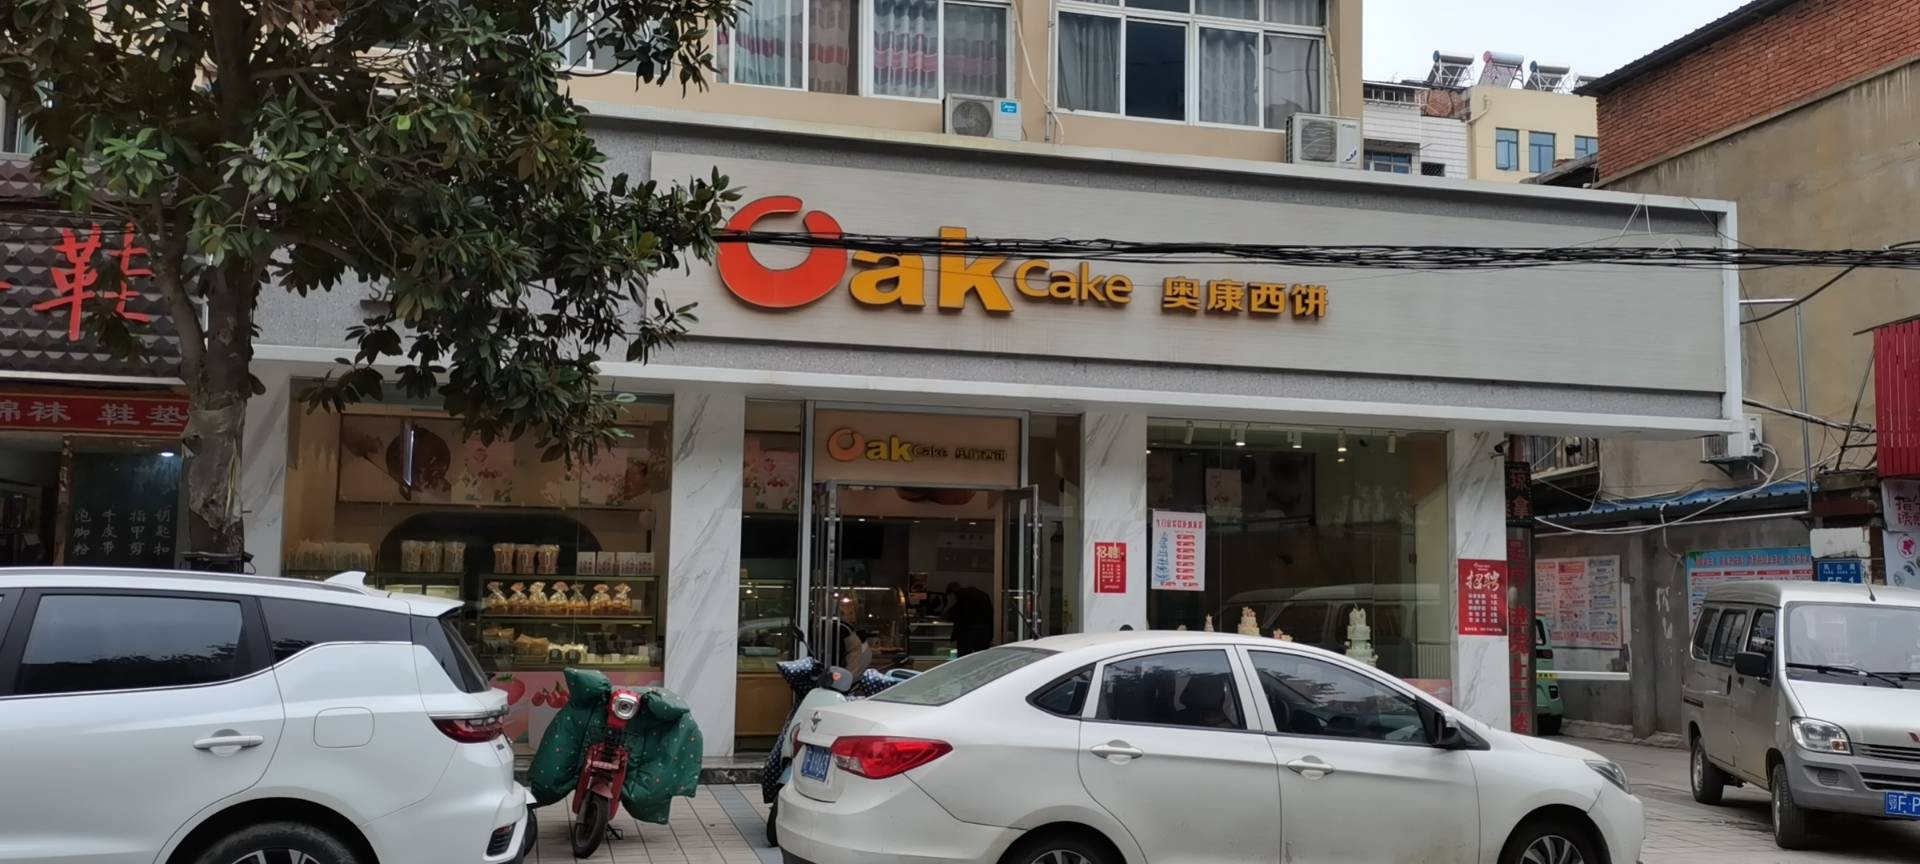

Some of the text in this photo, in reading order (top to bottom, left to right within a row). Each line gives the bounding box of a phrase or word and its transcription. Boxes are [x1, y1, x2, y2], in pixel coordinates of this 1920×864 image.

[716, 195, 1132, 314] Oak Cake
[1161, 274, 1329, 319] 奥康西饼
[97, 402, 190, 427] 鞋垫
[827, 427, 913, 462] Oak
[1465, 570, 1500, 592] 招聘
